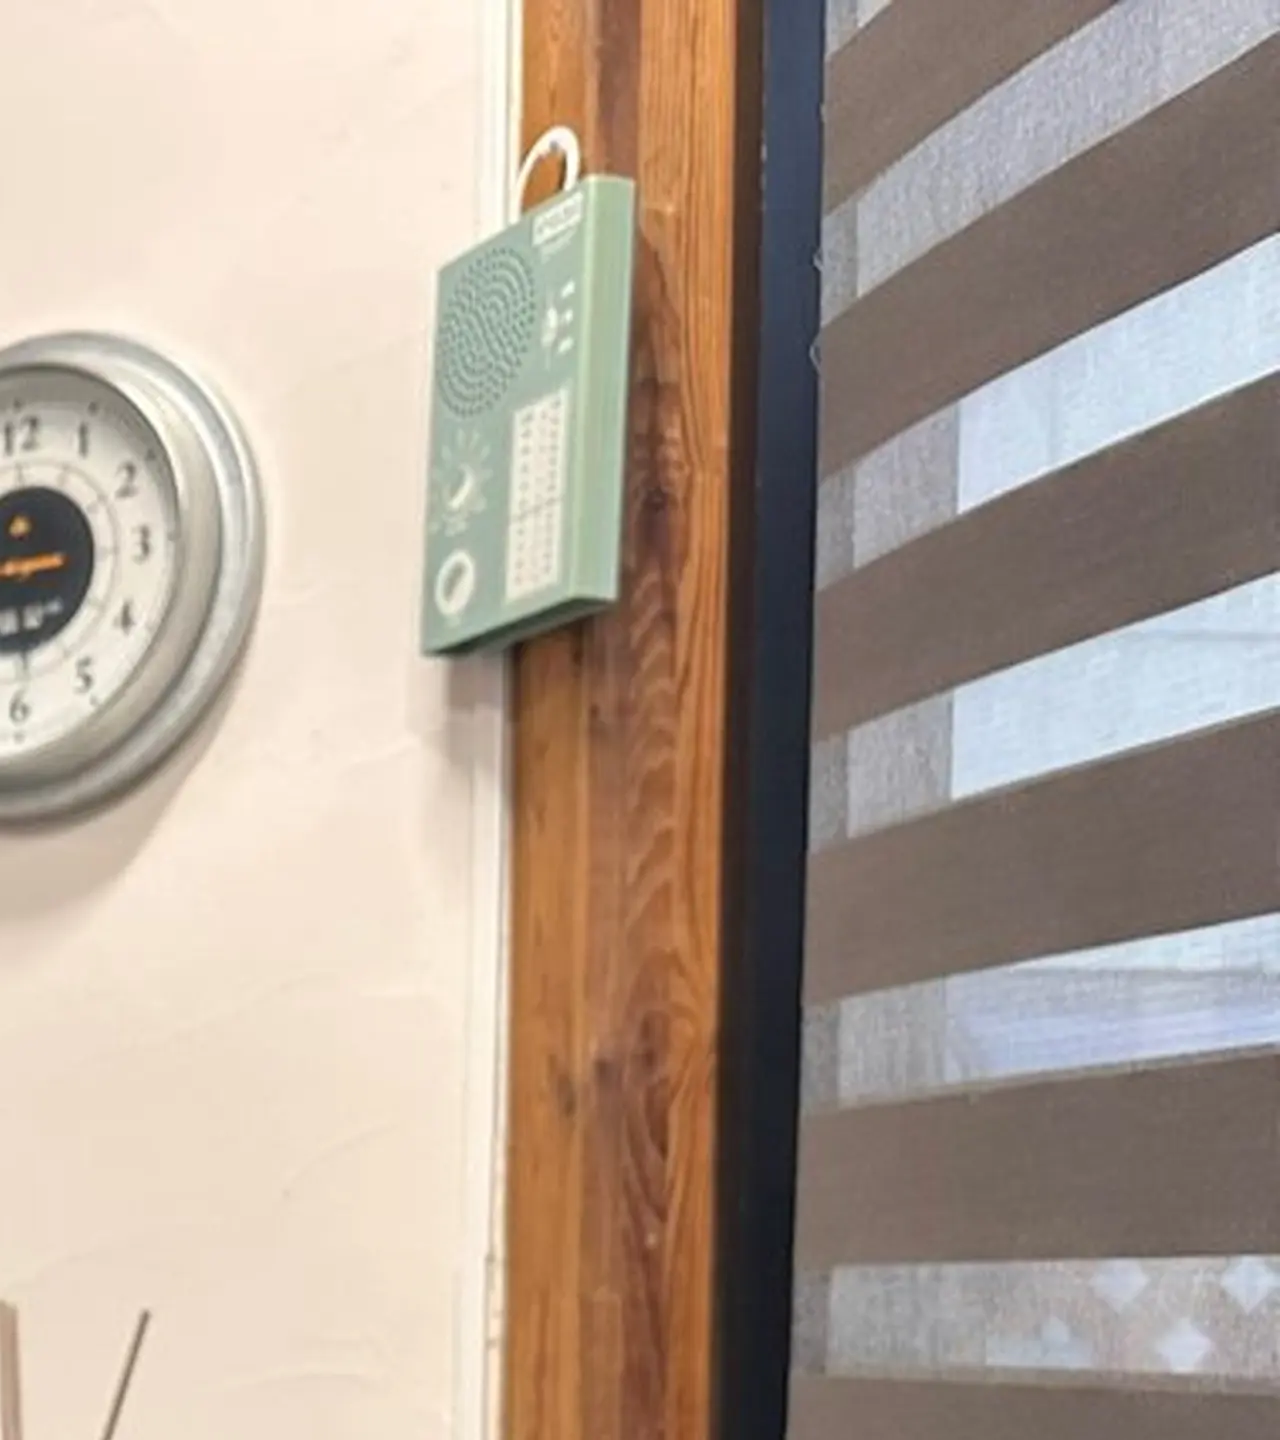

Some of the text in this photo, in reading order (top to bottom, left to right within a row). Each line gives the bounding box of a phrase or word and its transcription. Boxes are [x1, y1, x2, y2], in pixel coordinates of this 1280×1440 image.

[4, 415, 40, 456] 12
[76, 422, 91, 455] 1
[116, 462, 137, 499] 2
[134, 528, 151, 564] 3
[116, 603, 134, 634] 4
[74, 658, 94, 694] 5
[9, 695, 30, 724] 6
